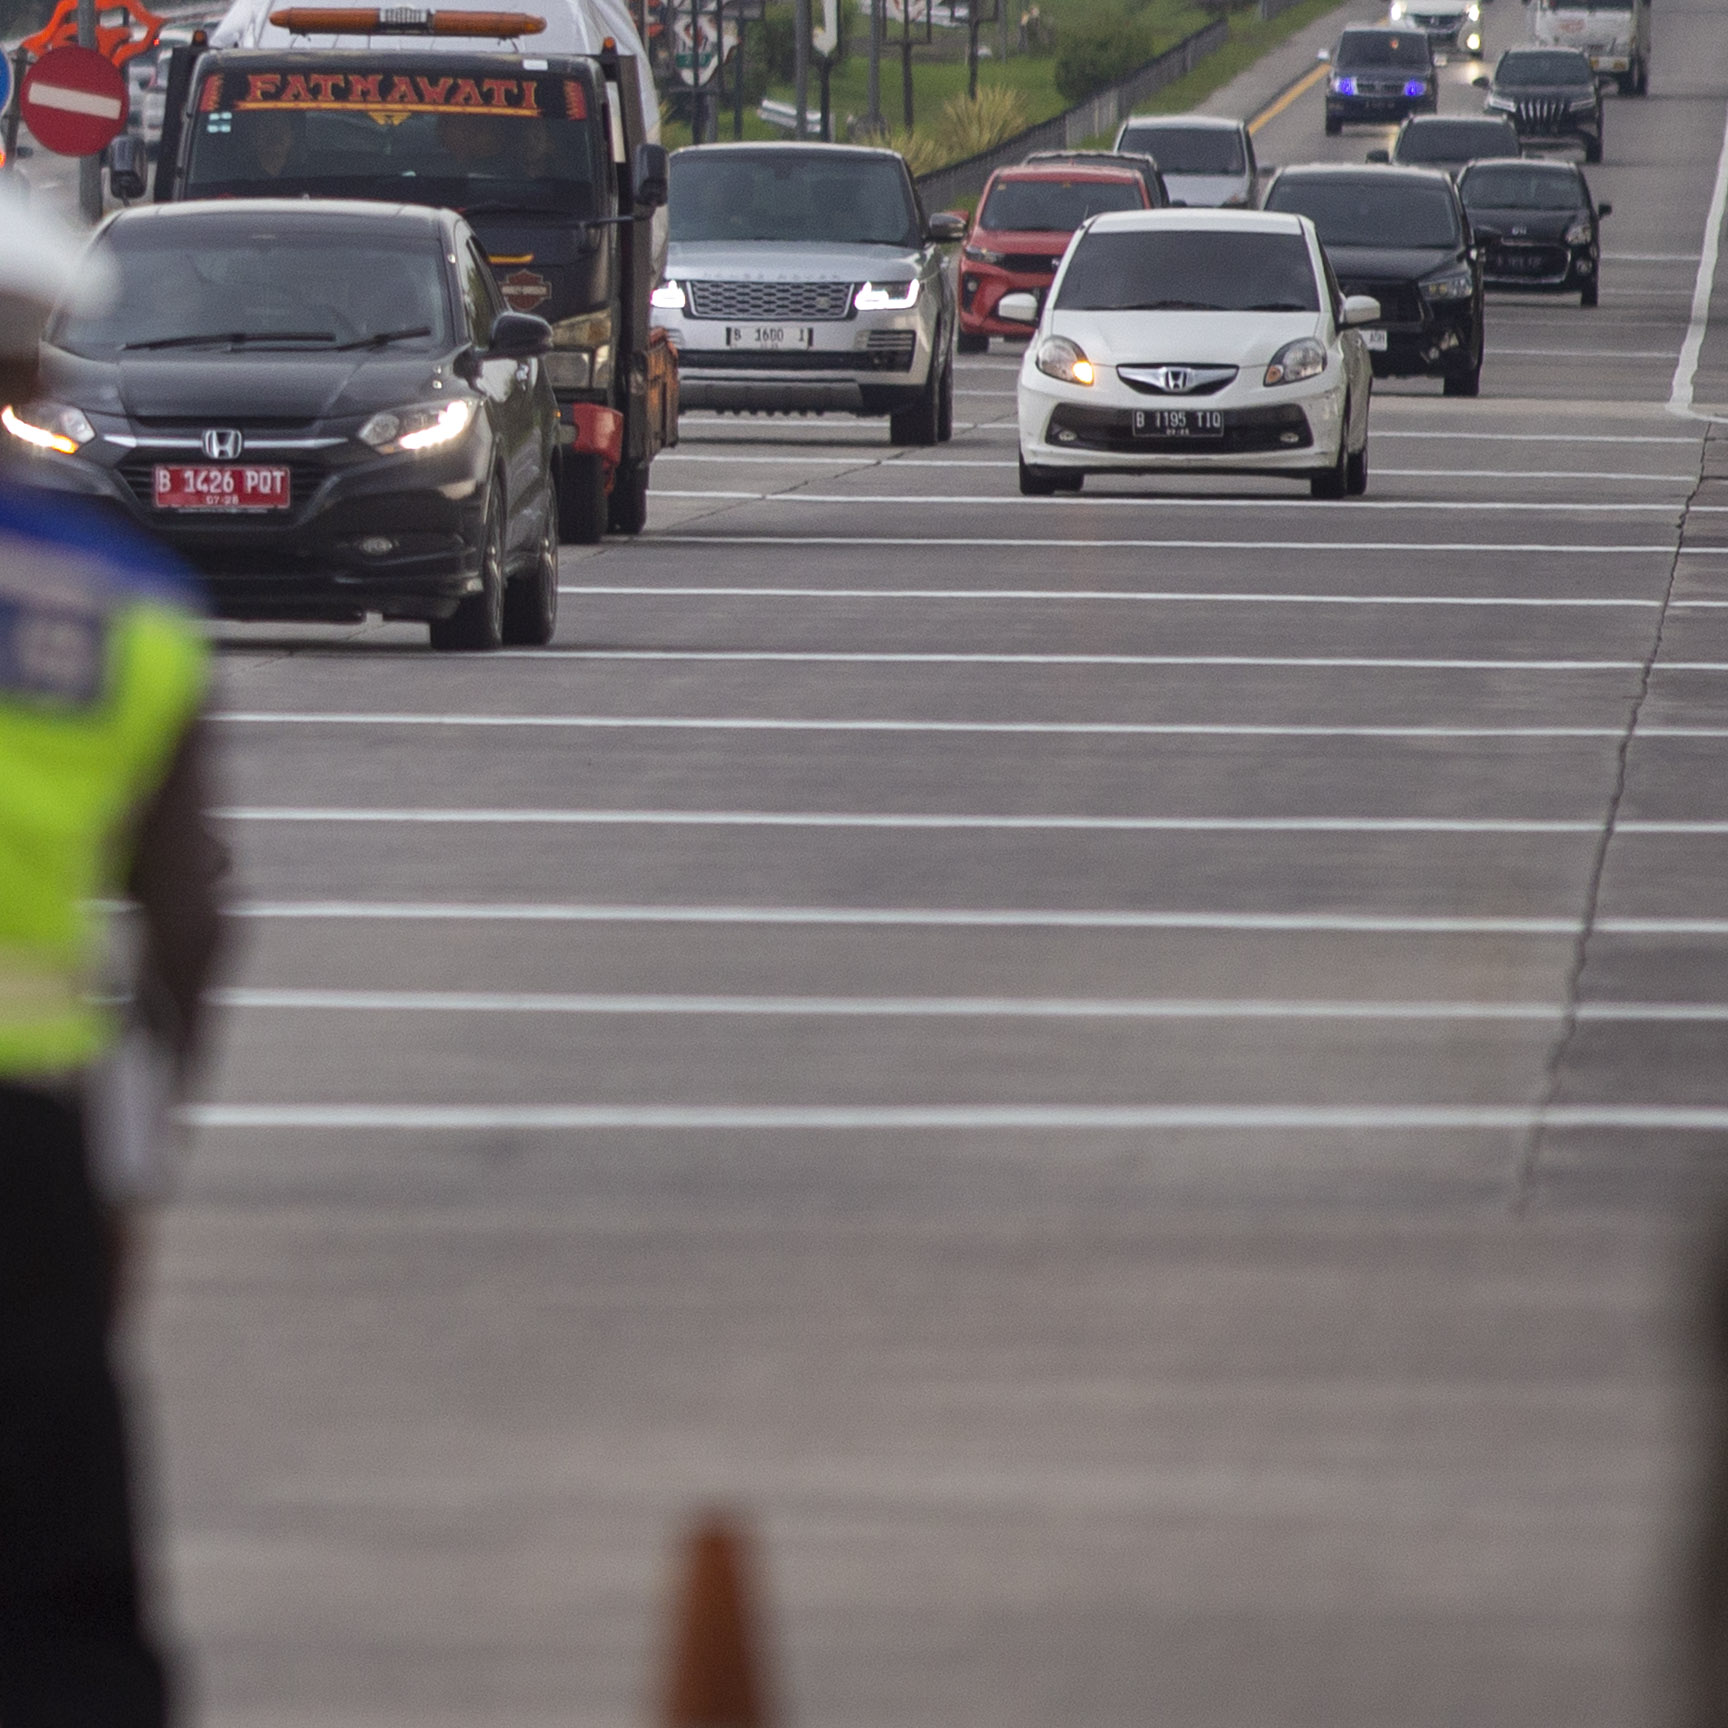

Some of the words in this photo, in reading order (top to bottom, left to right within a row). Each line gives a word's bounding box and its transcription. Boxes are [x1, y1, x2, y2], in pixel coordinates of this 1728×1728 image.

[245, 72, 539, 109] FATMAWATI
[1136, 411, 1146, 428] B
[1155, 411, 1187, 428] 1195
[158, 469, 172, 493] B
[184, 469, 235, 493] 1426
